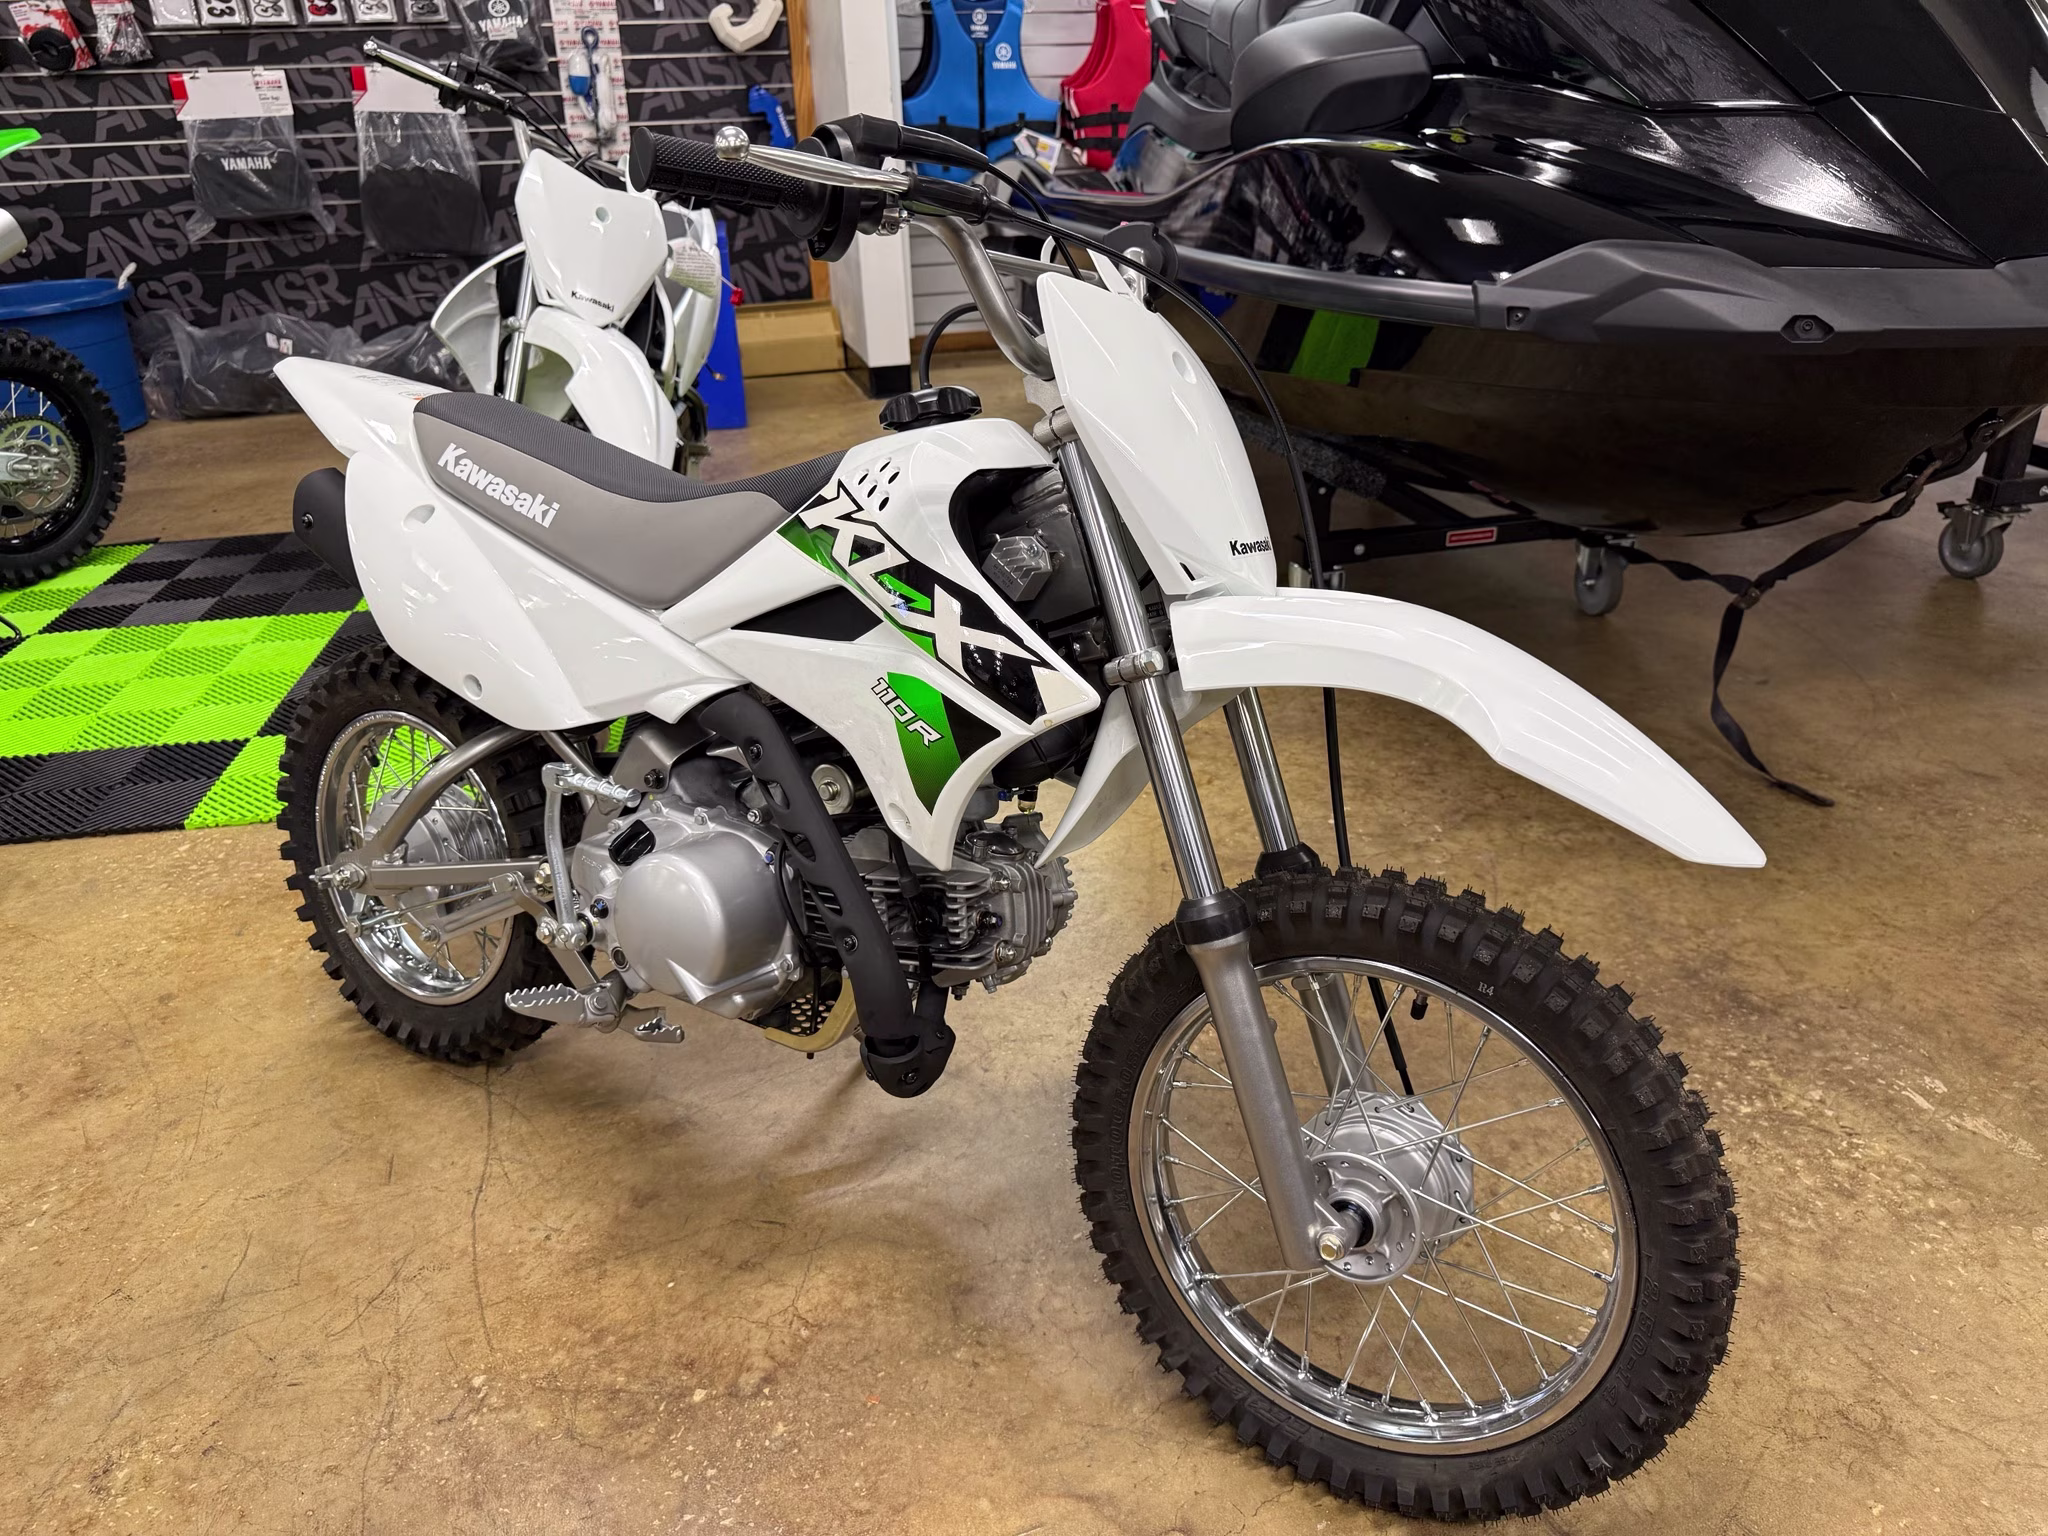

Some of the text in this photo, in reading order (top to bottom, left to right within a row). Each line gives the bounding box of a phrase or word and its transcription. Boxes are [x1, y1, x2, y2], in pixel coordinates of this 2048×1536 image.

[220, 156, 273, 171] YAMAHA
[436, 443, 560, 529] Kawasaki
[797, 478, 1042, 686] KLX
[871, 676, 945, 750] 110R
[1478, 982, 1495, 996] R4
[1602, 1275, 1661, 1407] 2.50-14
